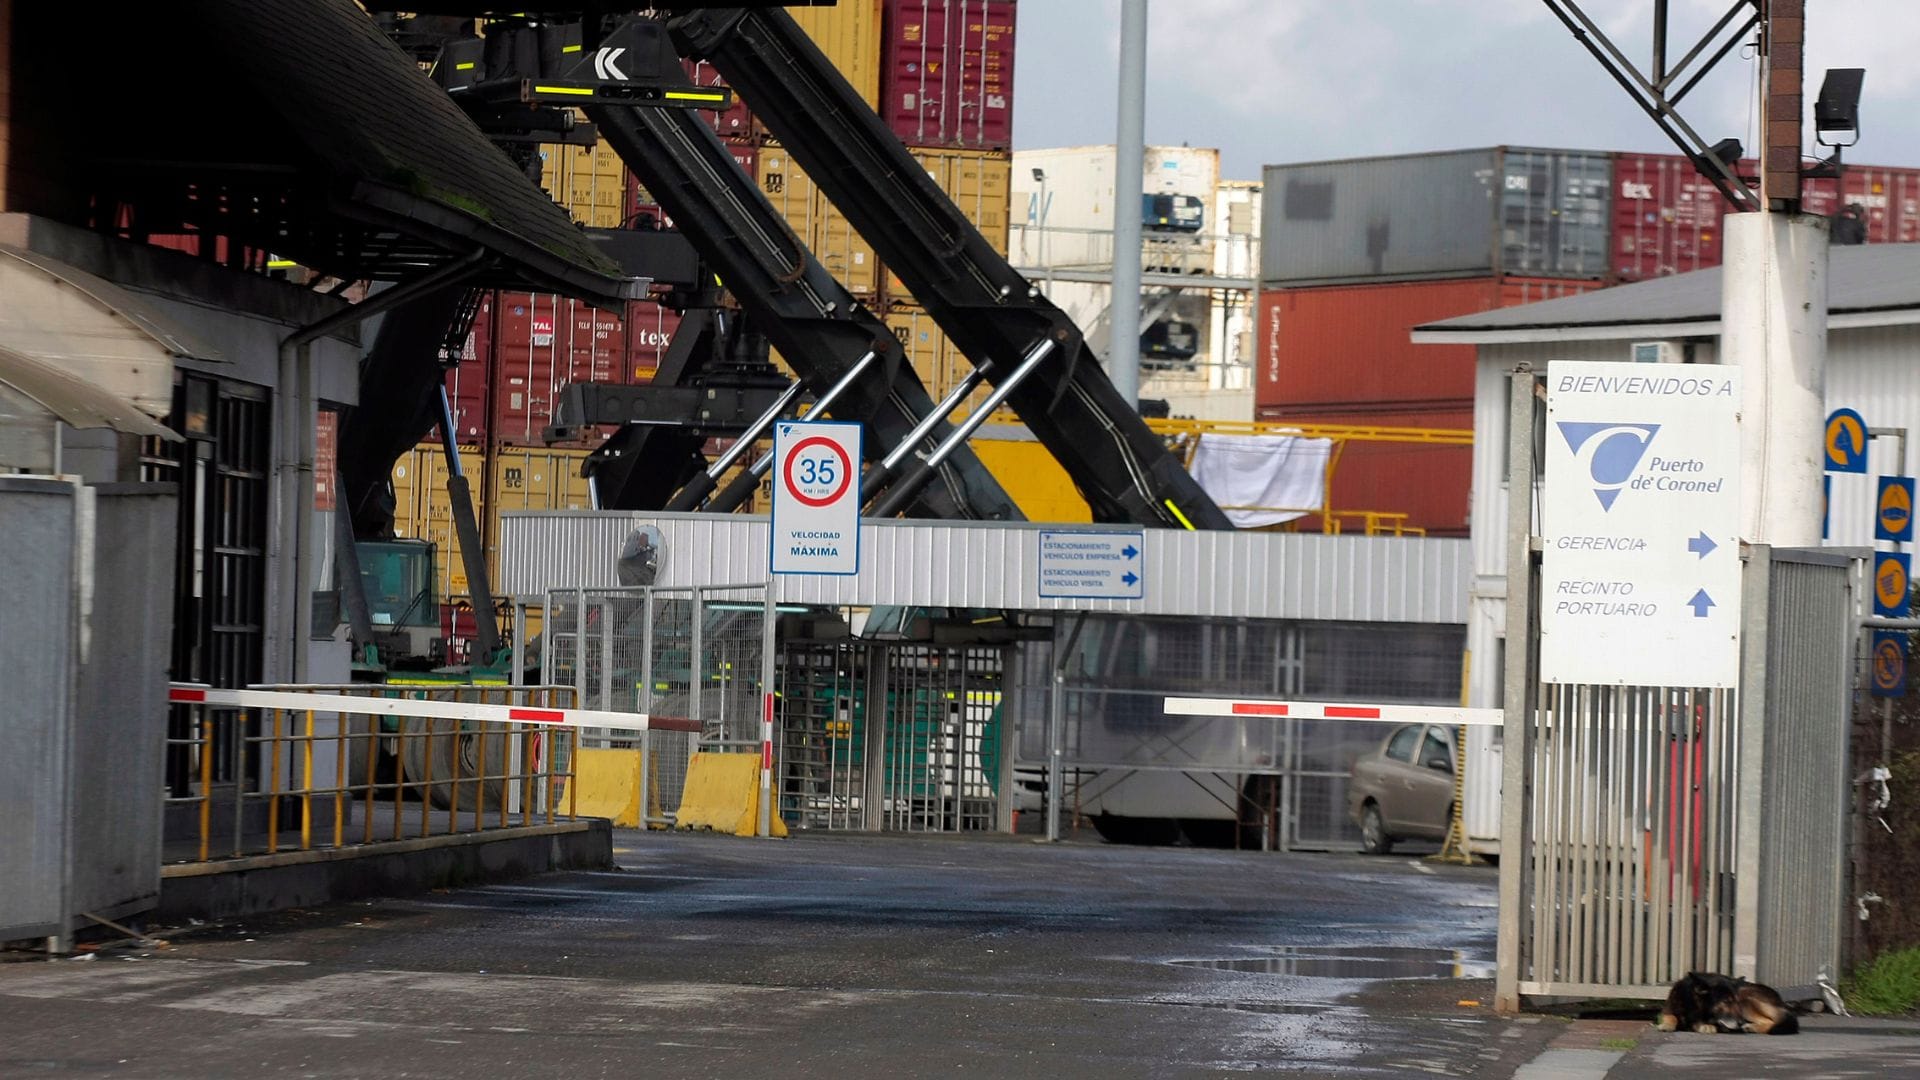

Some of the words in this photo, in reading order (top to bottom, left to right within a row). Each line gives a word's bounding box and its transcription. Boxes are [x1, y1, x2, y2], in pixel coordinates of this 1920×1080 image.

[533, 322, 552, 331] TAL
[640, 328, 670, 347] tex
[1558, 375, 1713, 396] BIENVENIDOS
[1716, 380, 1733, 396] A
[800, 458, 835, 485] 35
[1649, 457, 1704, 473] Puerto
[1630, 475, 1651, 490] de
[1656, 476, 1724, 493] Coronel
[791, 531, 841, 540] VELOCIDAD
[1556, 536, 1646, 551] GERENCIA
[1086, 553, 1121, 561] EMPRESA
[1043, 569, 1112, 577] ESTACIONAMIENTO
[1556, 581, 1635, 596] RECINTO
[1555, 601, 1658, 617] PORTUARIO
